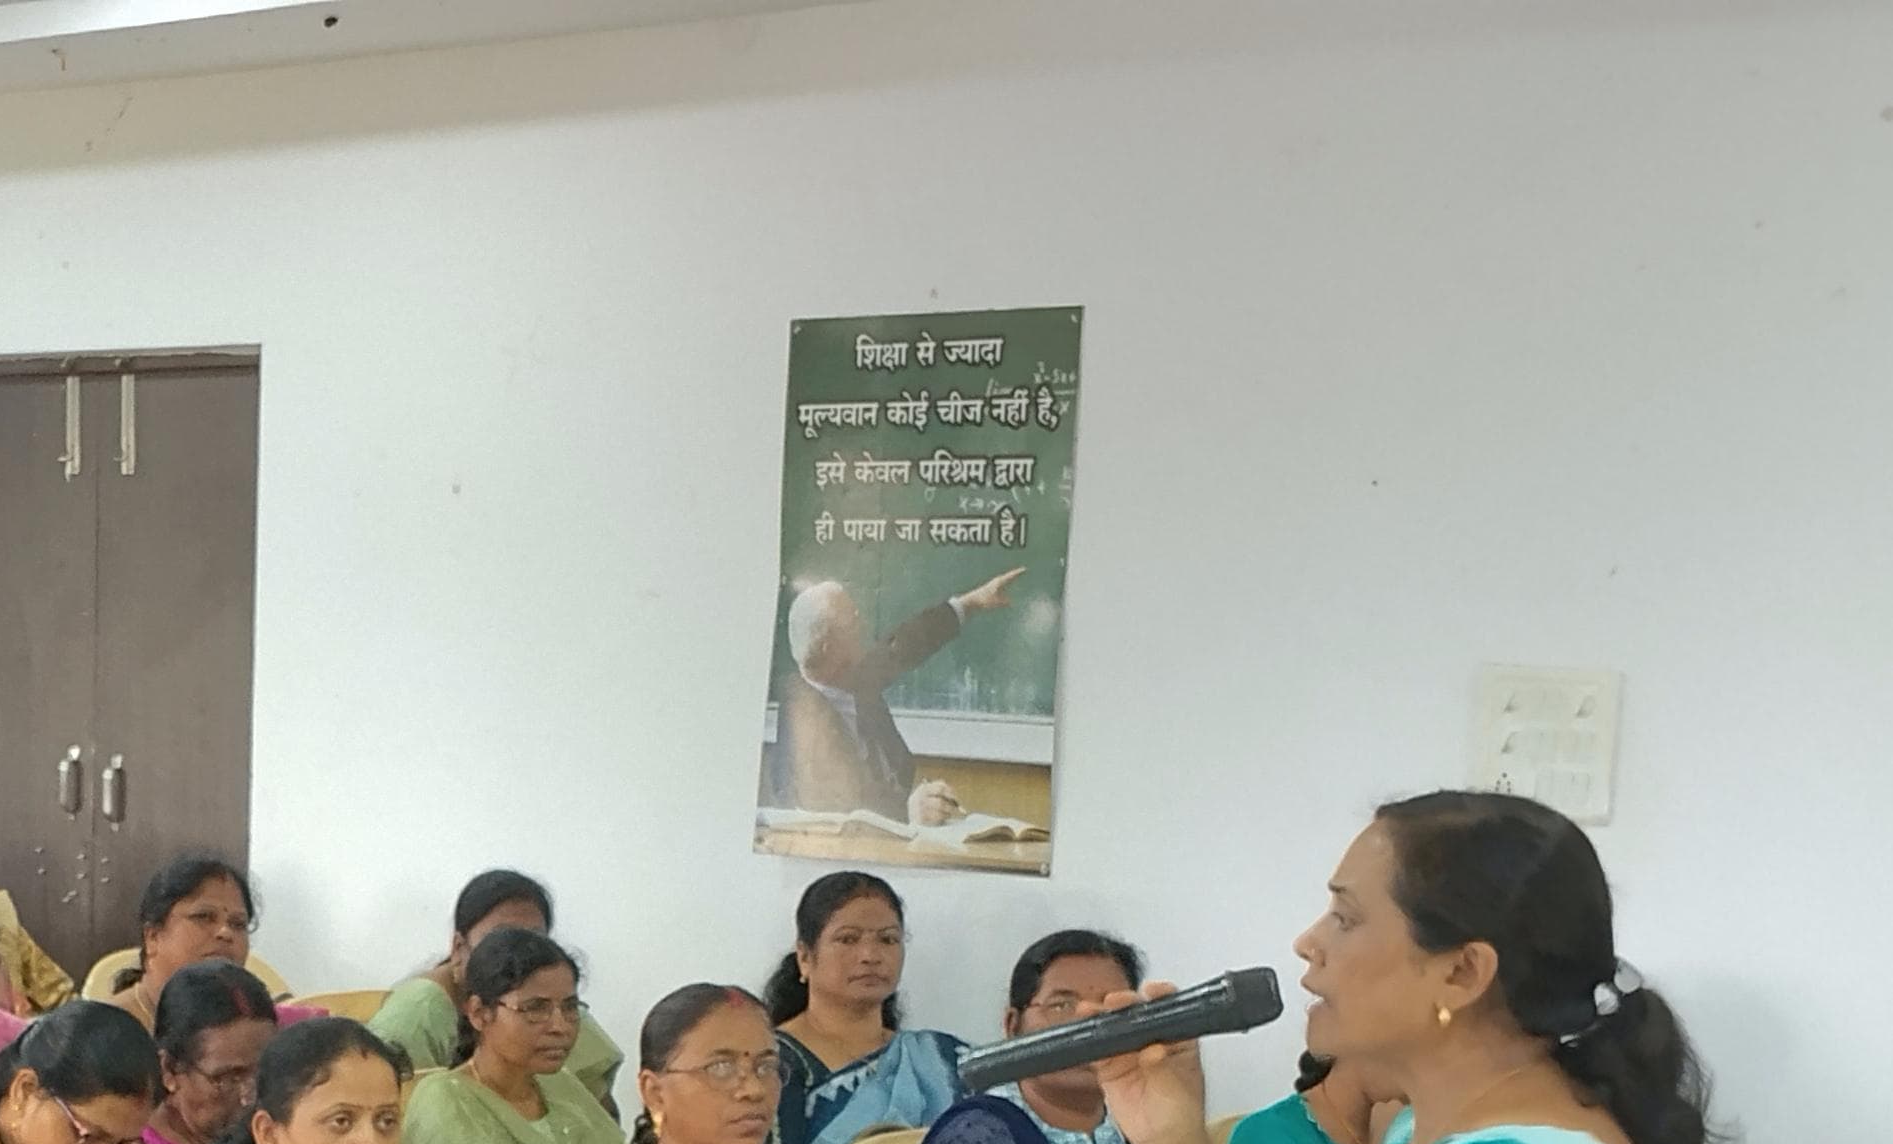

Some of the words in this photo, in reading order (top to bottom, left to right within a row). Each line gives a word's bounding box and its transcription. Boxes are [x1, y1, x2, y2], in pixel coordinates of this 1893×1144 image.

[855, 334, 909, 370] शिक्षा
[916, 332, 935, 367] से
[943, 337, 1003, 365] ज्यादा
[798, 401, 879, 438] मूल्यवान
[887, 391, 928, 431] कोई
[938, 391, 983, 425] चीज
[991, 387, 1028, 425] नहीं
[1036, 387, 1059, 428] है,
[815, 453, 845, 488] इसे
[855, 452, 910, 484] केवल
[919, 450, 986, 484] परिश्रम
[994, 456, 1034, 487] द्वारा
[814, 512, 834, 544] ही
[844, 518, 887, 542] पाया
[895, 518, 921, 542] जा
[930, 519, 991, 543] सकता
